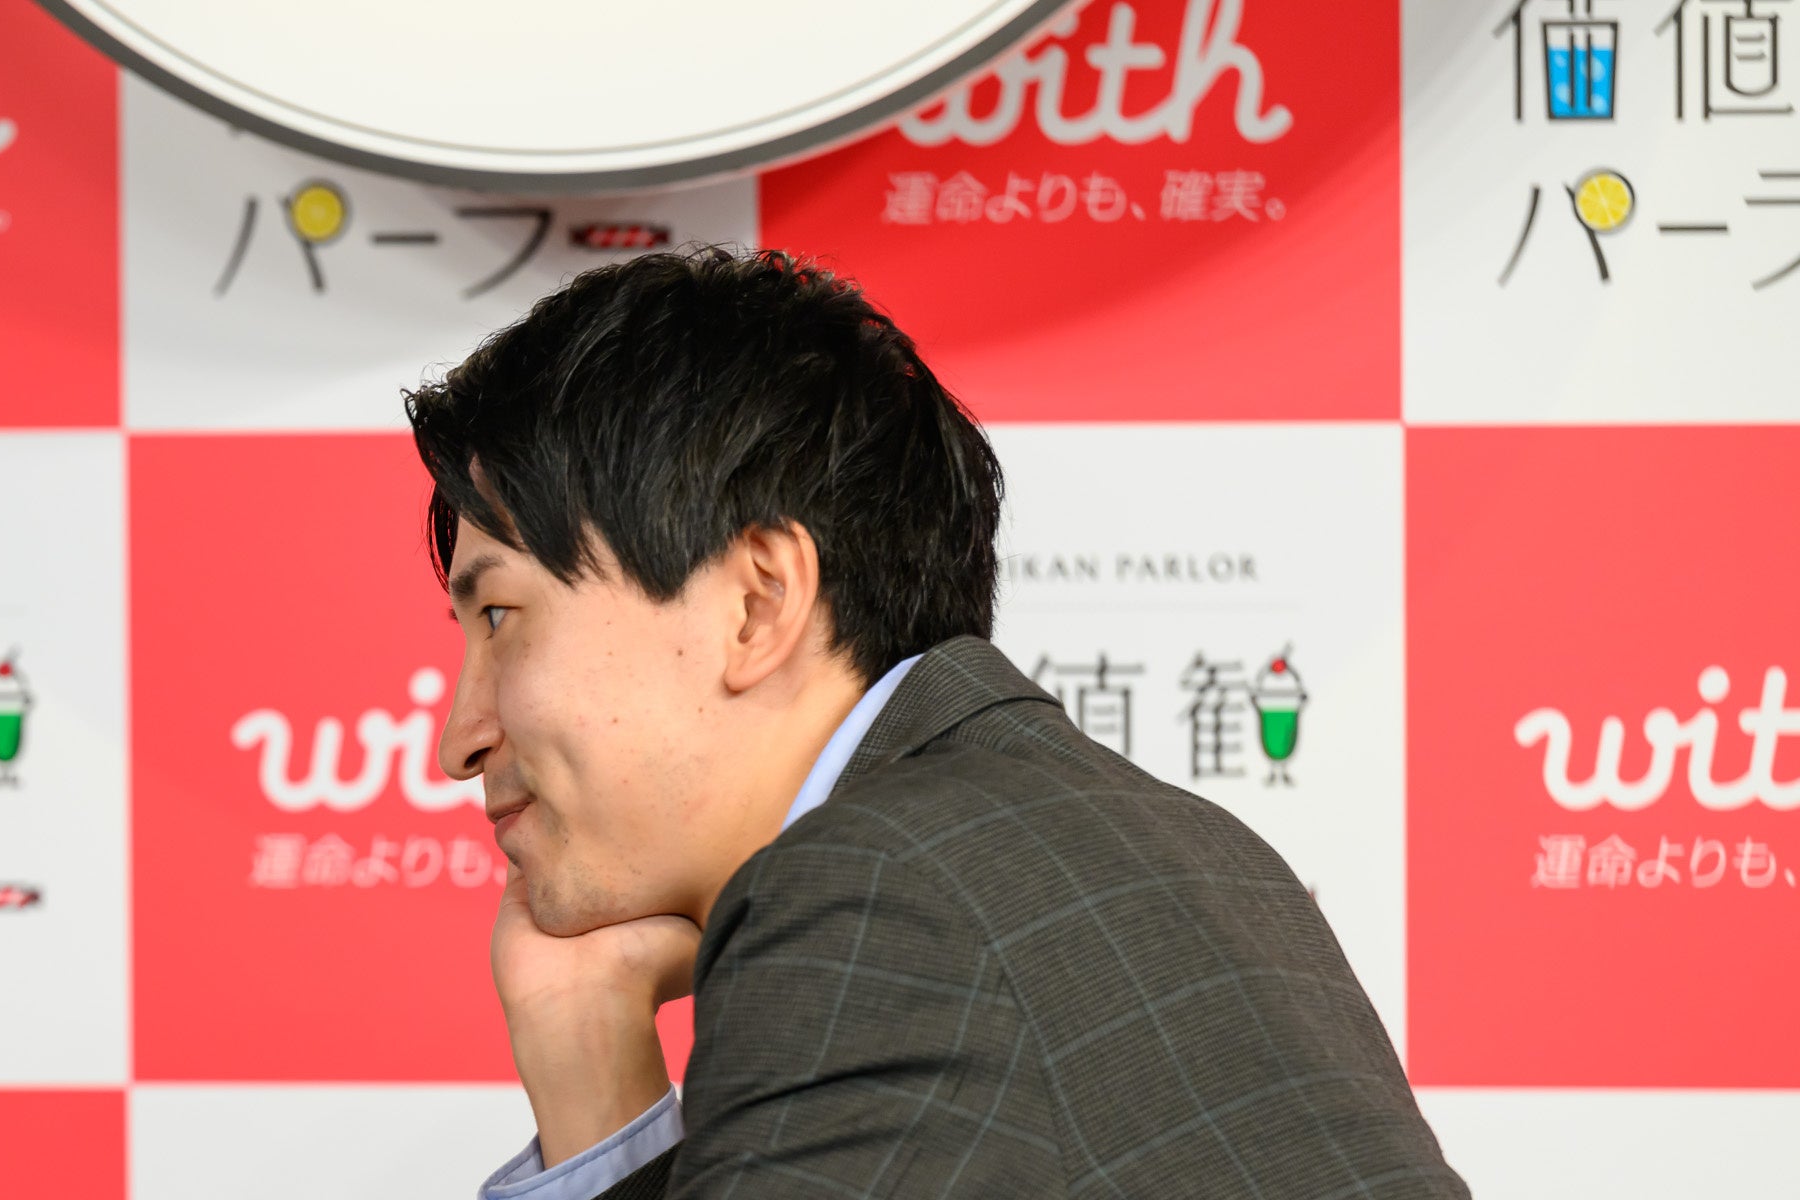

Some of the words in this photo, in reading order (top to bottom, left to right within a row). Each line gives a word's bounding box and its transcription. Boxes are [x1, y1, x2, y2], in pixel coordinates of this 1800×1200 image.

[882, 170, 1287, 225] 運命よりも、確実。
[1114, 553, 1258, 583] PARLOR
[231, 667, 486, 812] wi
[250, 833, 506, 888] 運命よりも、
